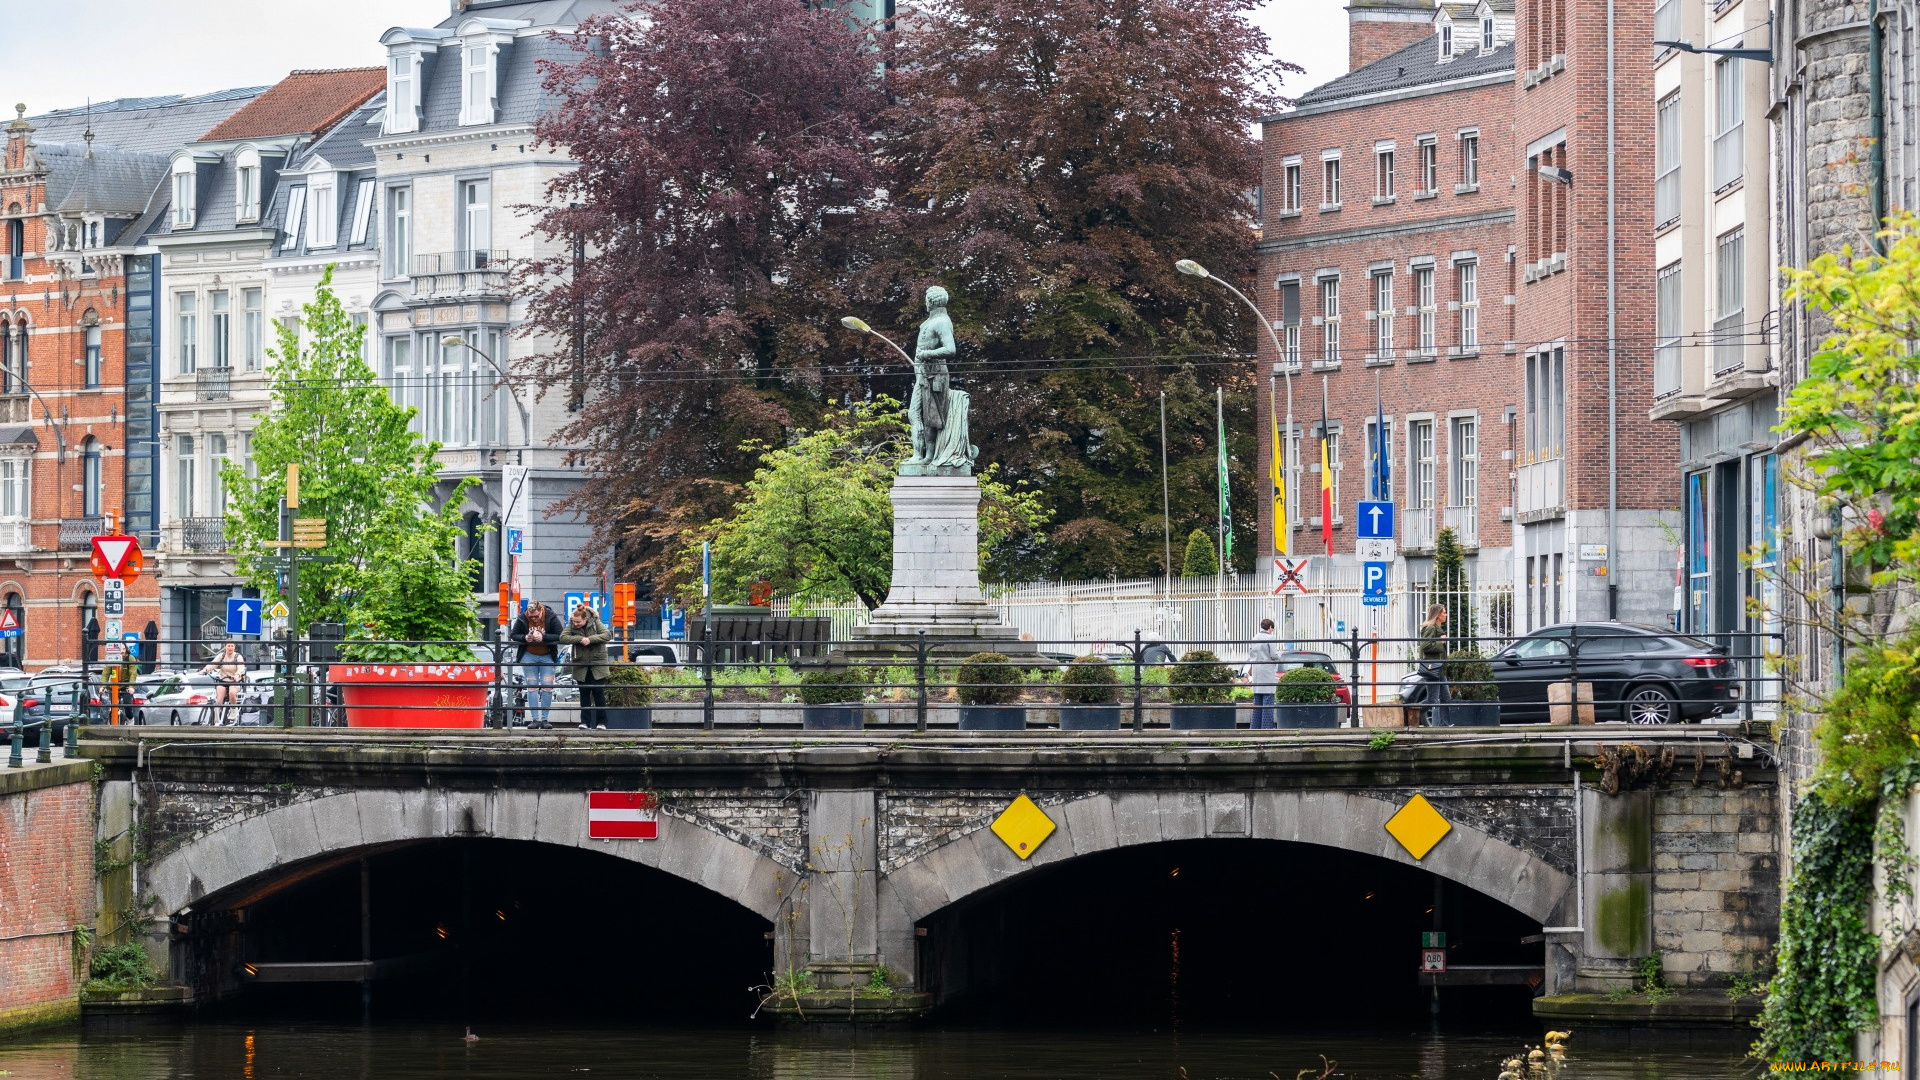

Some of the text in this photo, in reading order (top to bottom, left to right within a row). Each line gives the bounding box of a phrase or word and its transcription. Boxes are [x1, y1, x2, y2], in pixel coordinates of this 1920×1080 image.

[1367, 566, 1383, 590] P
[671, 608, 683, 626] P
[3, 630, 17, 638] 10m
[1426, 954, 1442, 964] 0,80
